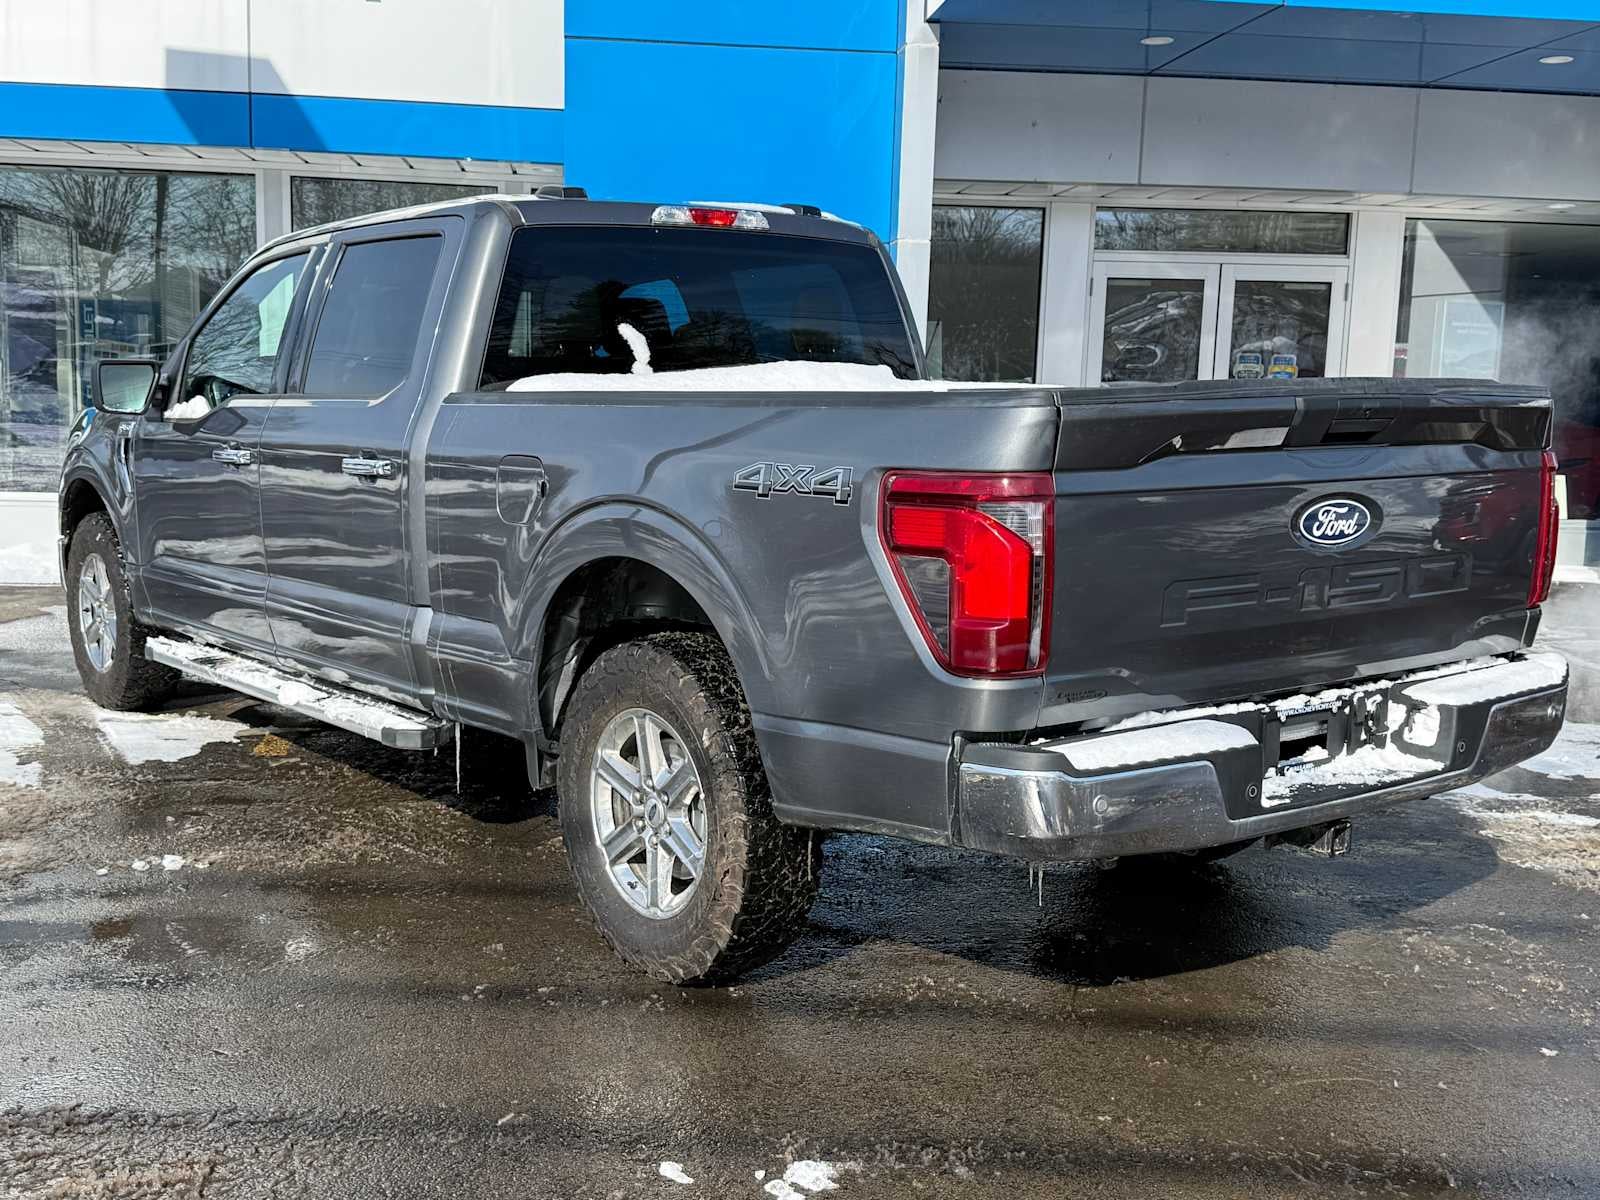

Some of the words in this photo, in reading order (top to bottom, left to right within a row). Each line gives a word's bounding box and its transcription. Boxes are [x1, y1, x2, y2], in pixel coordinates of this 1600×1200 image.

[733, 461, 853, 506] 4X4
[1312, 506, 1360, 537] Ford
[1160, 553, 1472, 628] F-150
